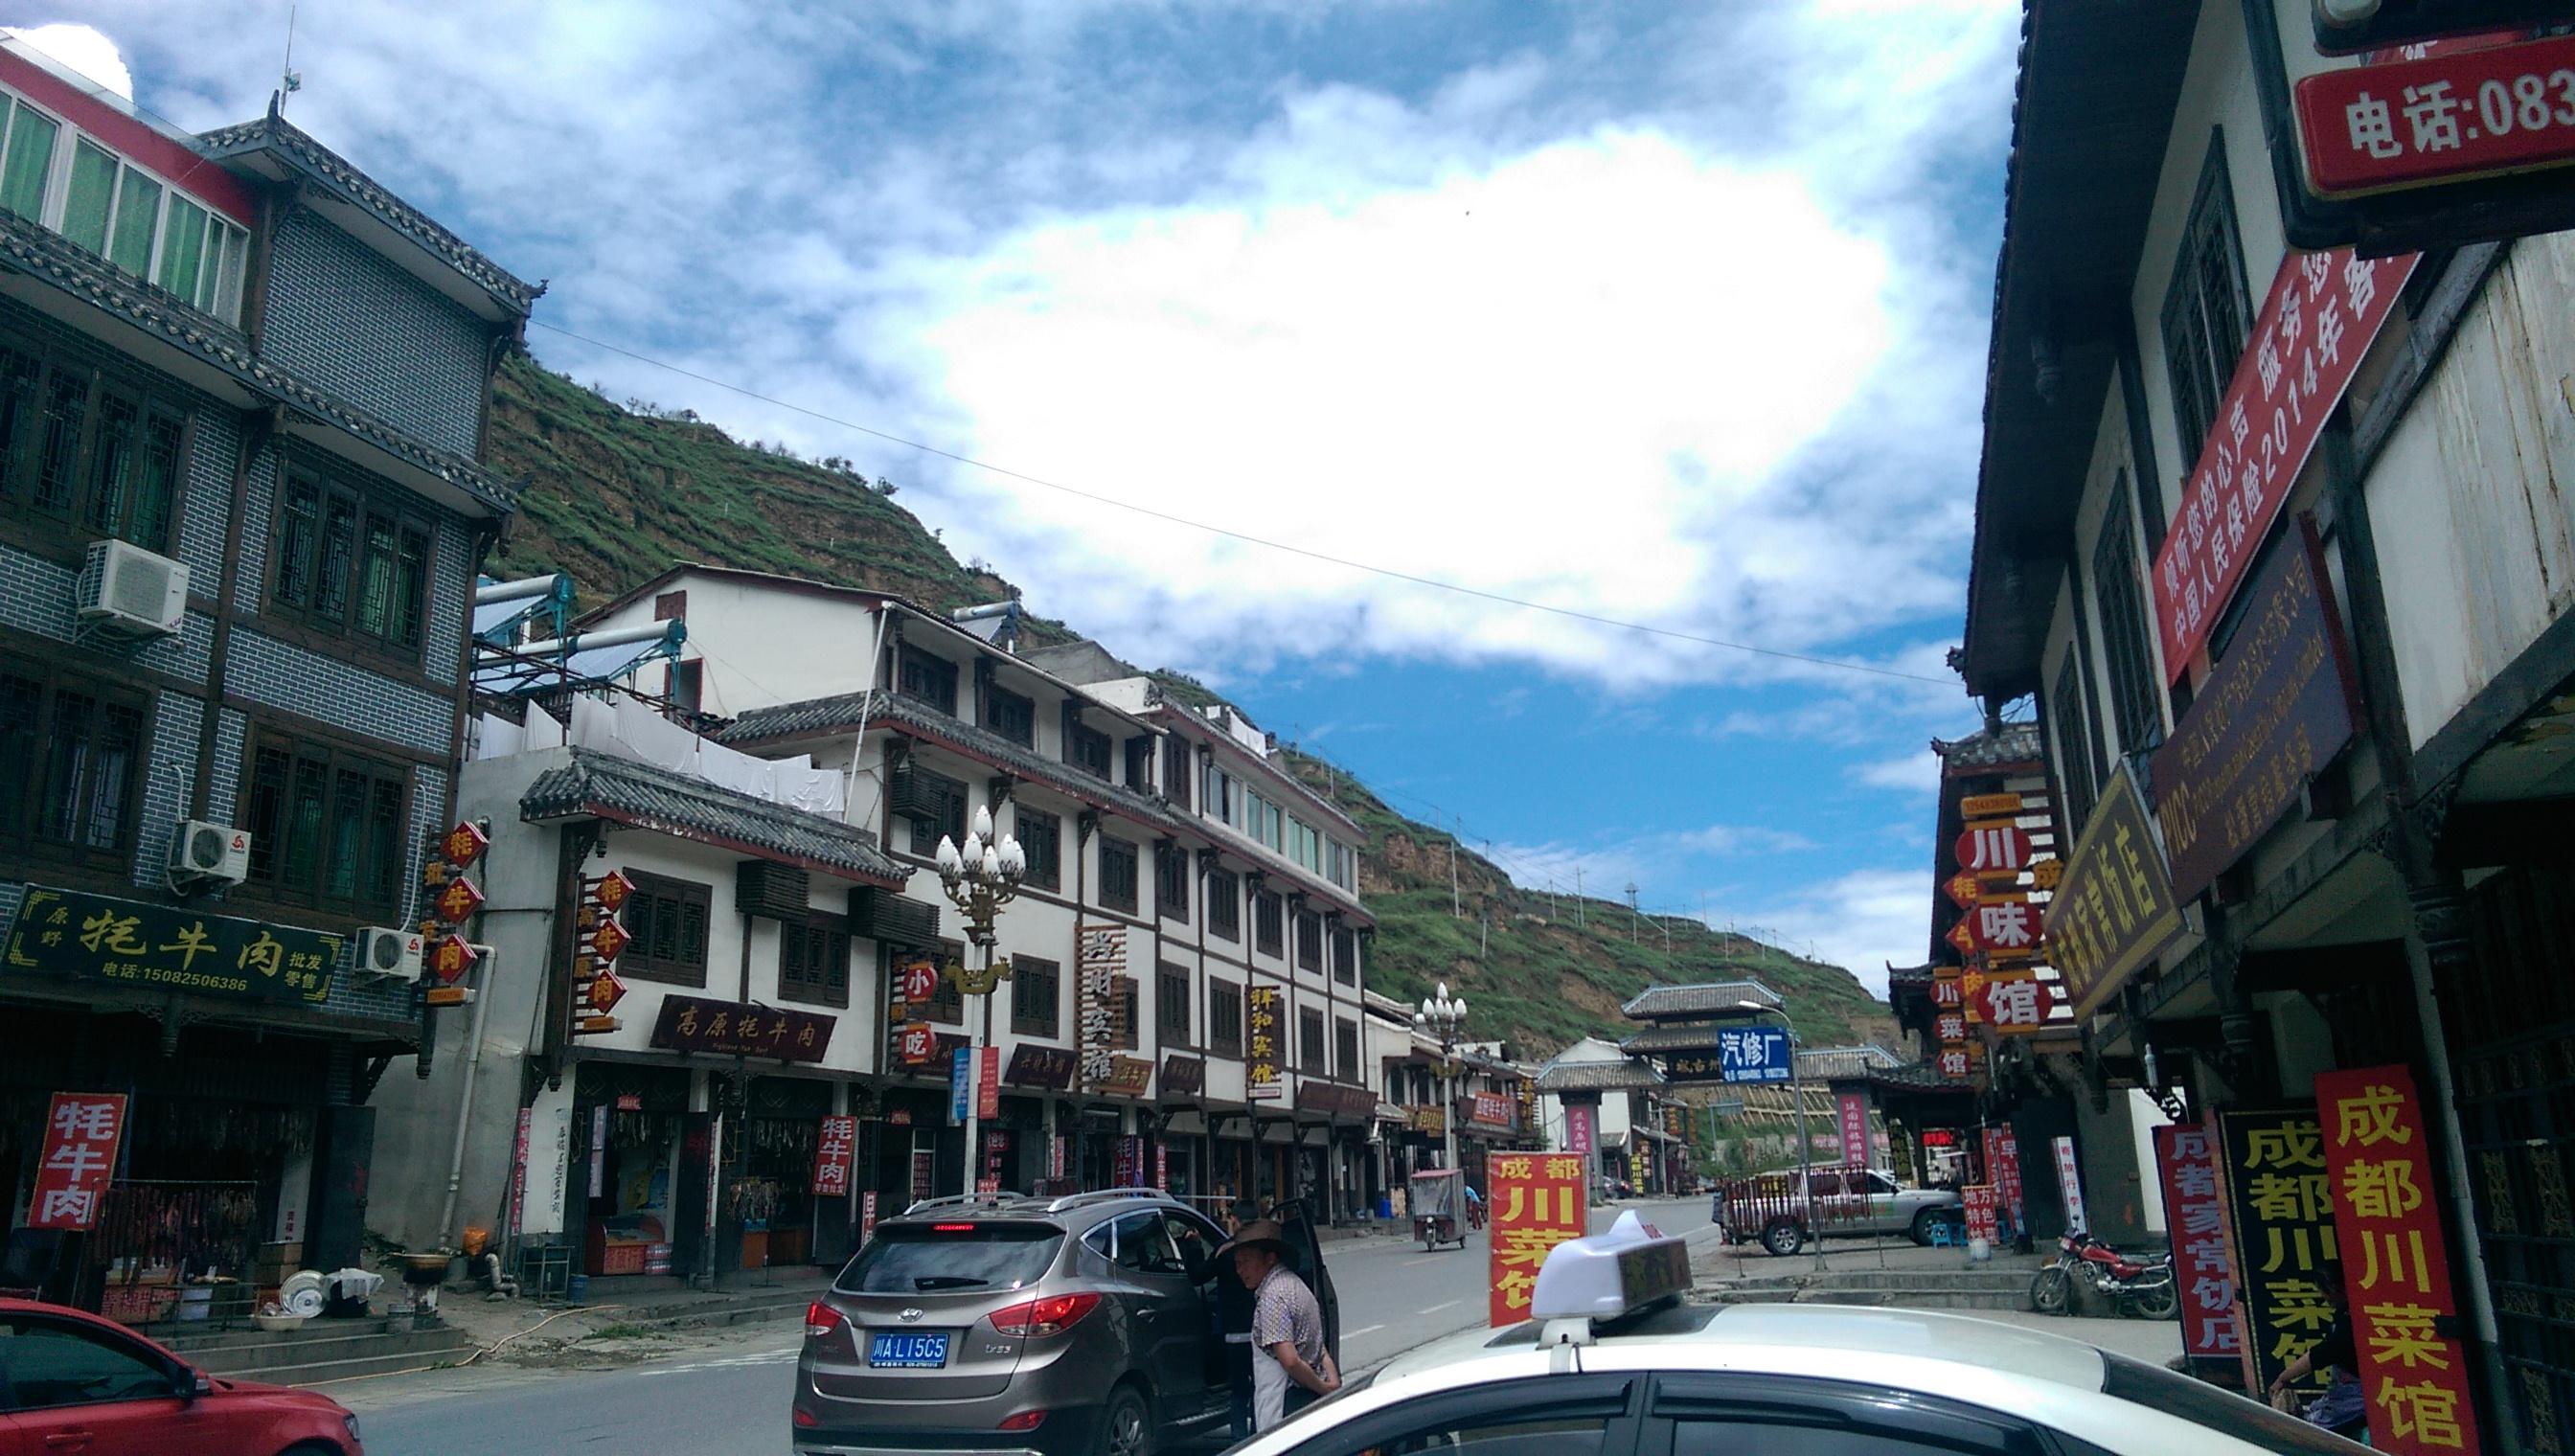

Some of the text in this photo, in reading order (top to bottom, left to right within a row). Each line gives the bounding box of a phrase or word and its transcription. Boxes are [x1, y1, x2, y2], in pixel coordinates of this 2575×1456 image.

[2163, 393, 2249, 603] 倾听您的心声
[2159, 779, 2198, 861] PICC
[437, 830, 473, 971] 牦牛肉
[592, 877, 623, 1004] 牦牛肉
[1971, 828, 2041, 1025] 川味馆
[2056, 819, 2157, 997] 成都家常饭店
[79, 909, 285, 978] 牦牛肉
[102, 961, 248, 992] 电话:15082506386
[284, 969, 319, 990] 零售
[288, 951, 324, 971] 批发
[675, 1005, 815, 1049] 高原牦牛肉
[903, 968, 929, 1055] 小吃
[1080, 931, 1113, 1081] 兴财宾馆
[1249, 988, 1275, 1083] 祥和宾馆
[1938, 984, 1965, 1075] 川菜馆
[1720, 1032, 1783, 1067] 汽修厂
[39, 1101, 115, 1224] 牦牛肉
[819, 1118, 853, 1184] 牦牛肉
[1499, 1157, 1581, 1181] 成都
[1965, 1189, 1993, 1205] 地方
[1967, 1208, 1995, 1225] 特色
[2336, 1084, 2463, 1449] 成都川菜馆
